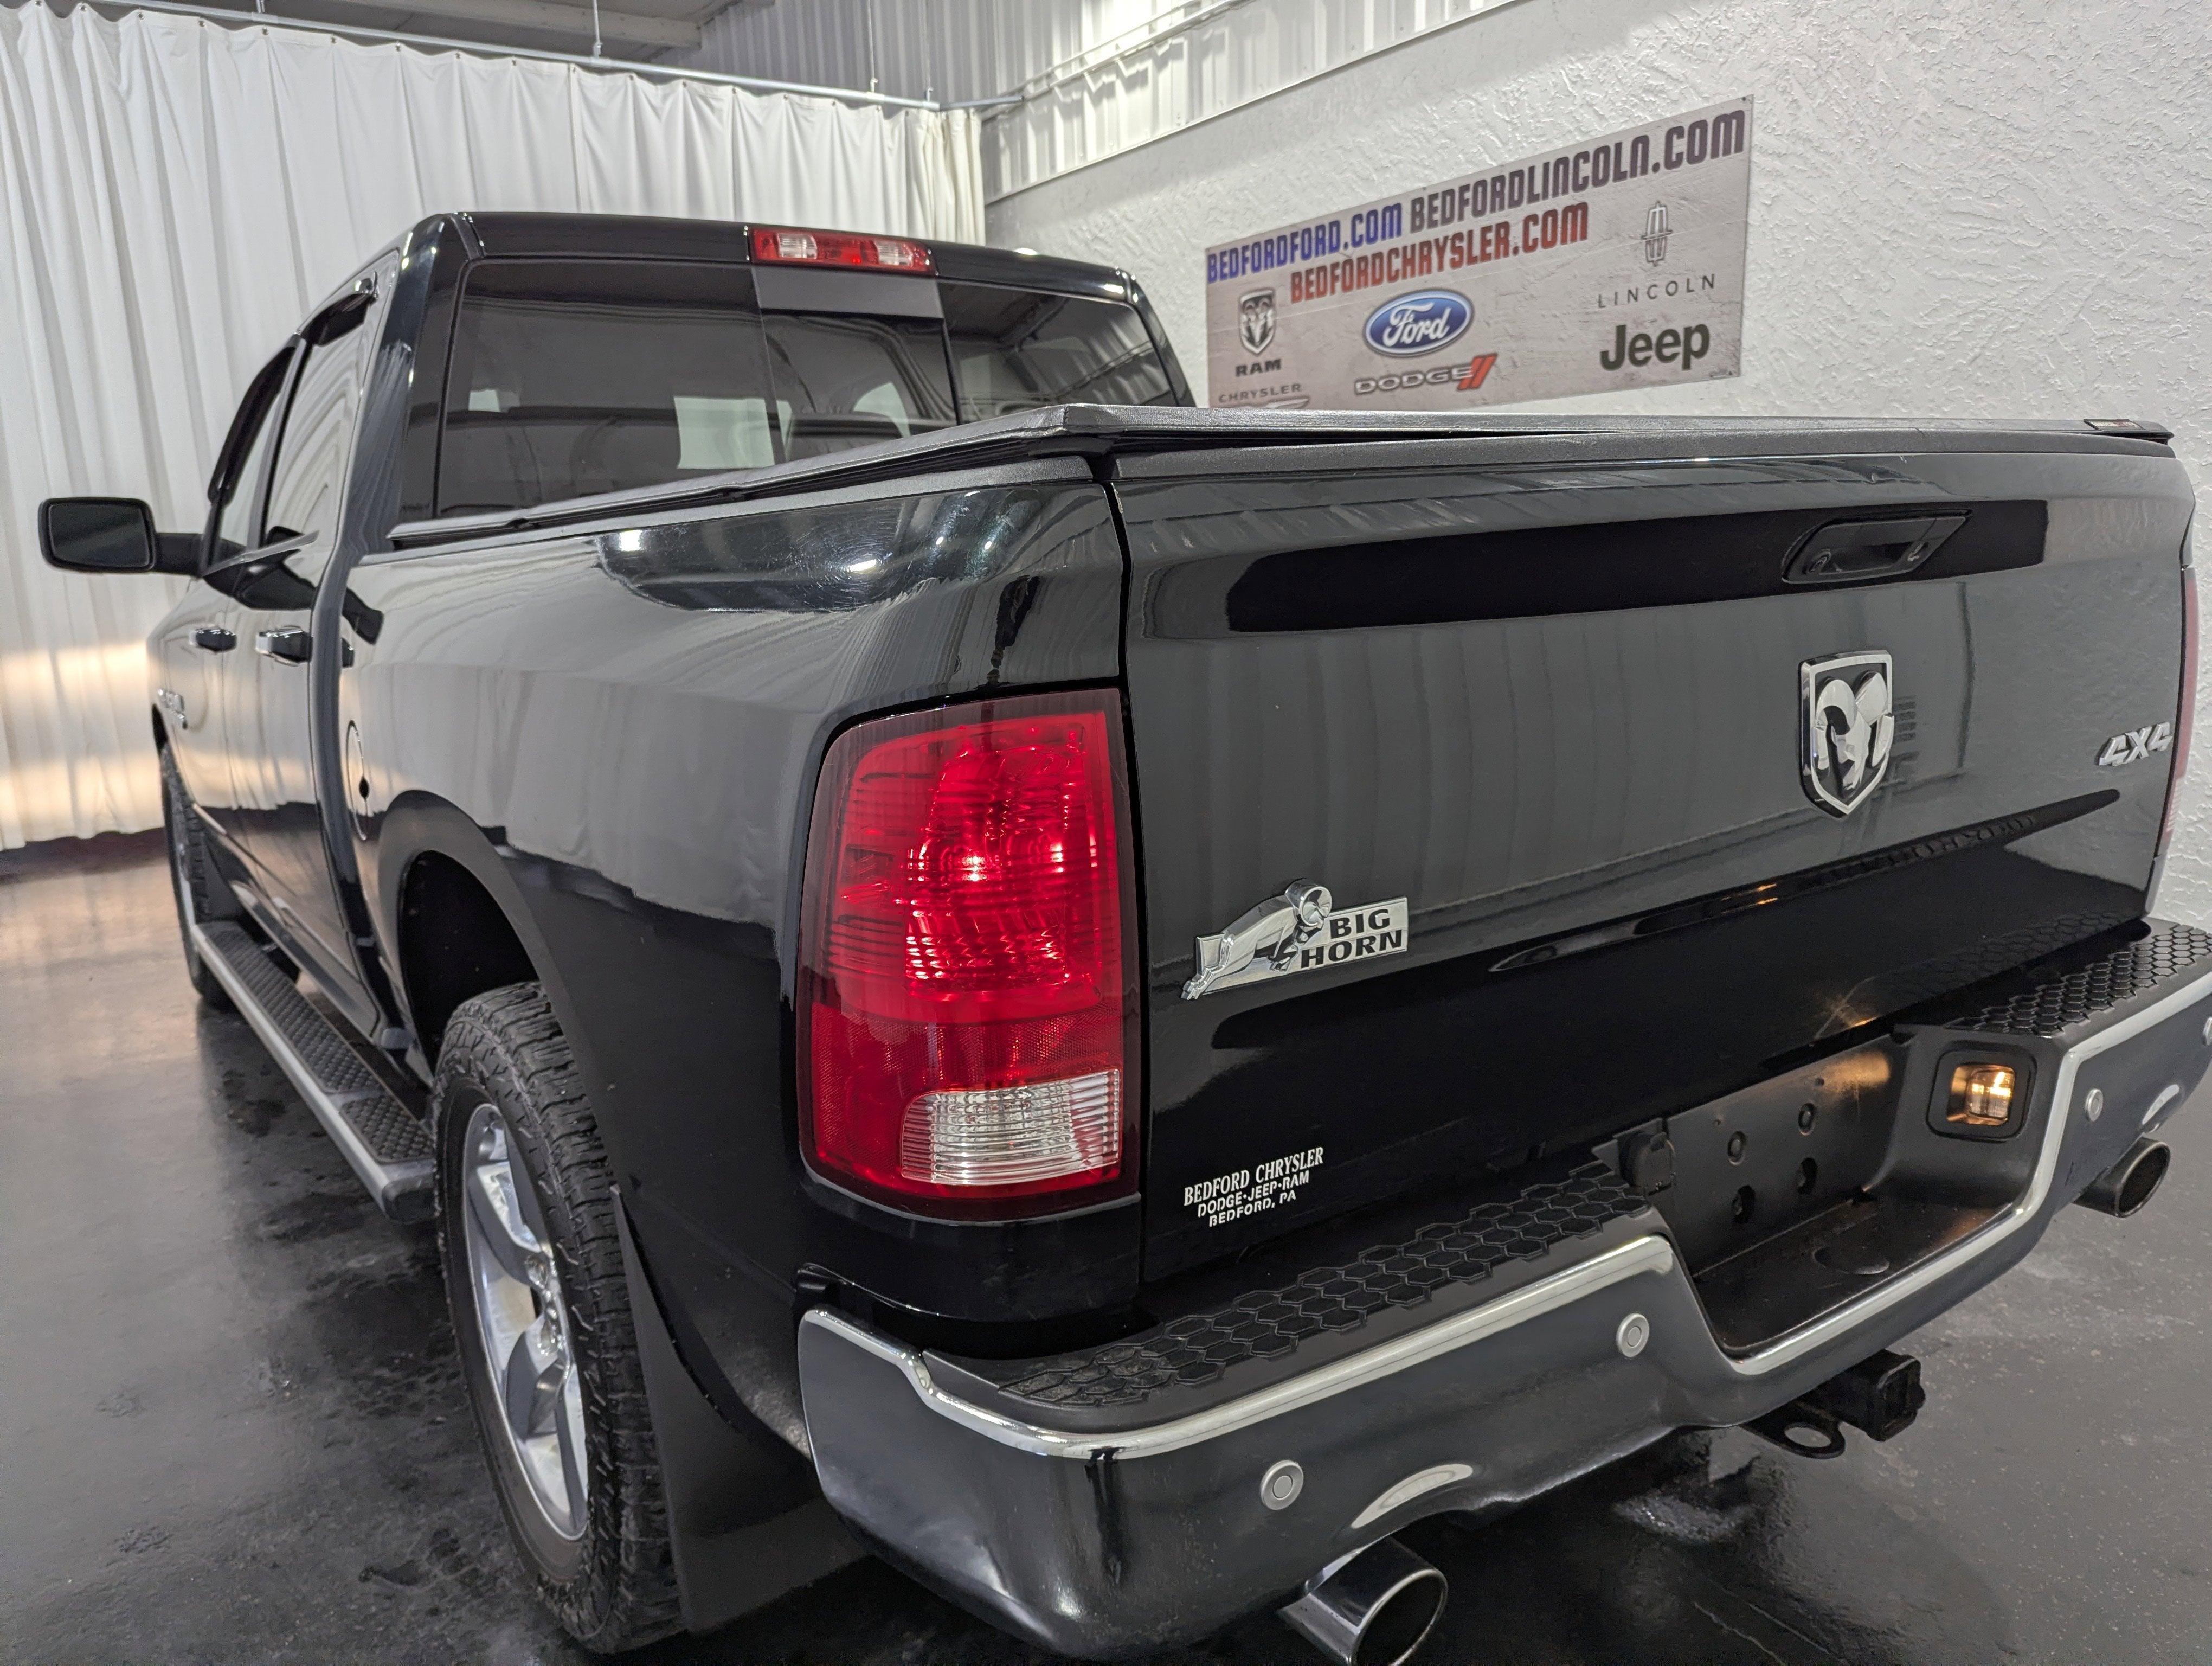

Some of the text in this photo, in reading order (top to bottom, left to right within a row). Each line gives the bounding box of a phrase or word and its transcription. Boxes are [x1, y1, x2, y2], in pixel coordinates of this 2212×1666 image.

[1207, 110, 1745, 284] BEDFORDFORD.COM BEDFORDLINCOLN.COM
[1290, 201, 1589, 304] BEDFORDCHRYSLER.COM
[1597, 273, 1715, 309] LINCOLN
[1382, 301, 1452, 347] Ford
[1235, 358, 1282, 377] RAM
[1599, 324, 1711, 371] Jeep
[1219, 383, 1302, 403] CHRYSLER
[1354, 362, 1474, 395] DODGE
[2098, 721, 2173, 767] 4X4
[1329, 909, 1390, 939] BIG
[1301, 929, 1402, 969] HORN
[1184, 1146, 1324, 1207] BEDFORD CHRYSLER
[1209, 1189, 1297, 1228] BEDFORD, PA
